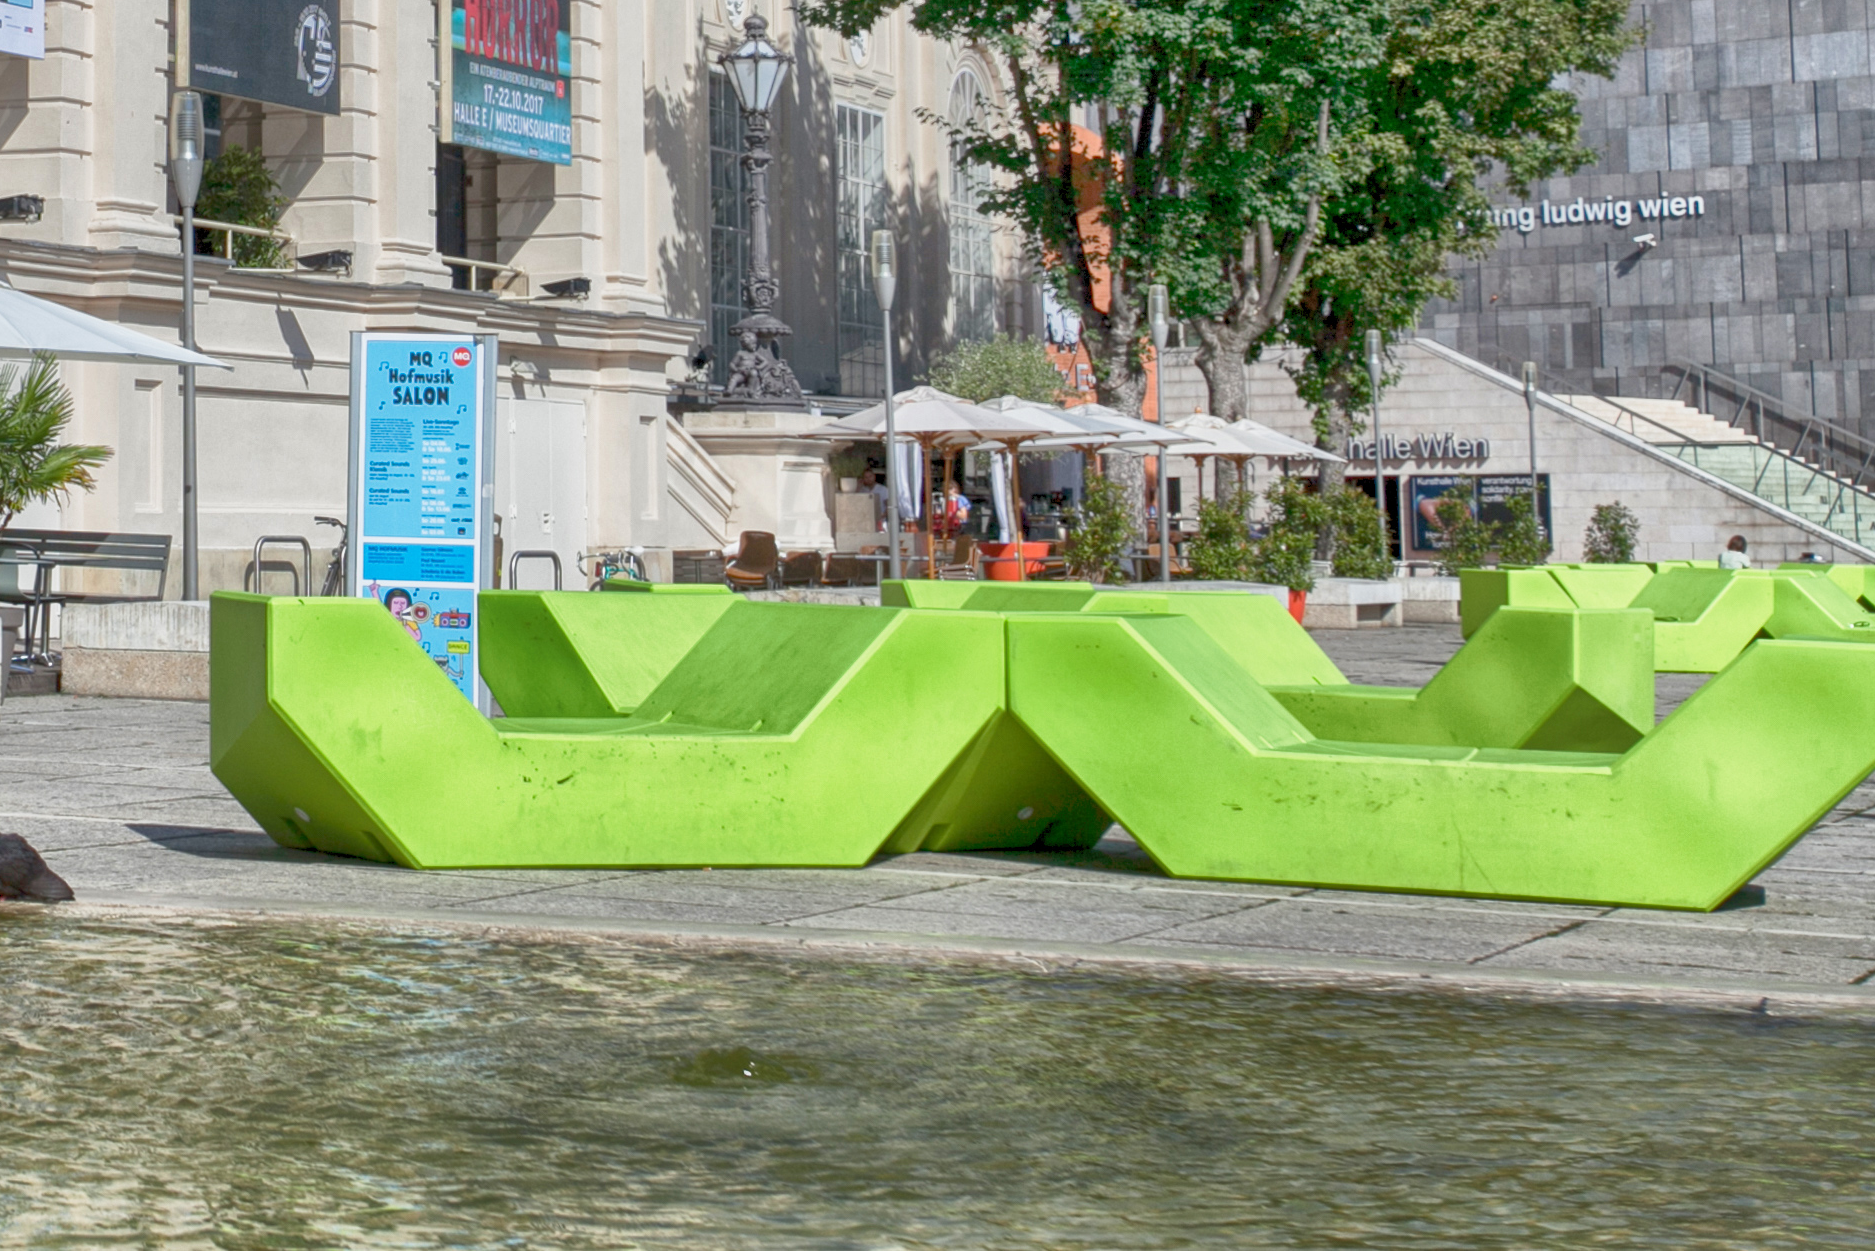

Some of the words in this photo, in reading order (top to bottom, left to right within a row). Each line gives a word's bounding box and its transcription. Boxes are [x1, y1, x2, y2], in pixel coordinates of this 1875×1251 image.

[454, 101, 480, 126] HALLE
[482, 108, 488, 128] E
[495, 110, 571, 145] MUSEUMSQUARTIER
[1541, 195, 1633, 227] ludwig
[1639, 191, 1706, 219] wien
[409, 350, 433, 368] MQ
[388, 367, 455, 385] Hofmusik
[392, 386, 450, 406] SALON
[1419, 432, 1491, 460] Wien
